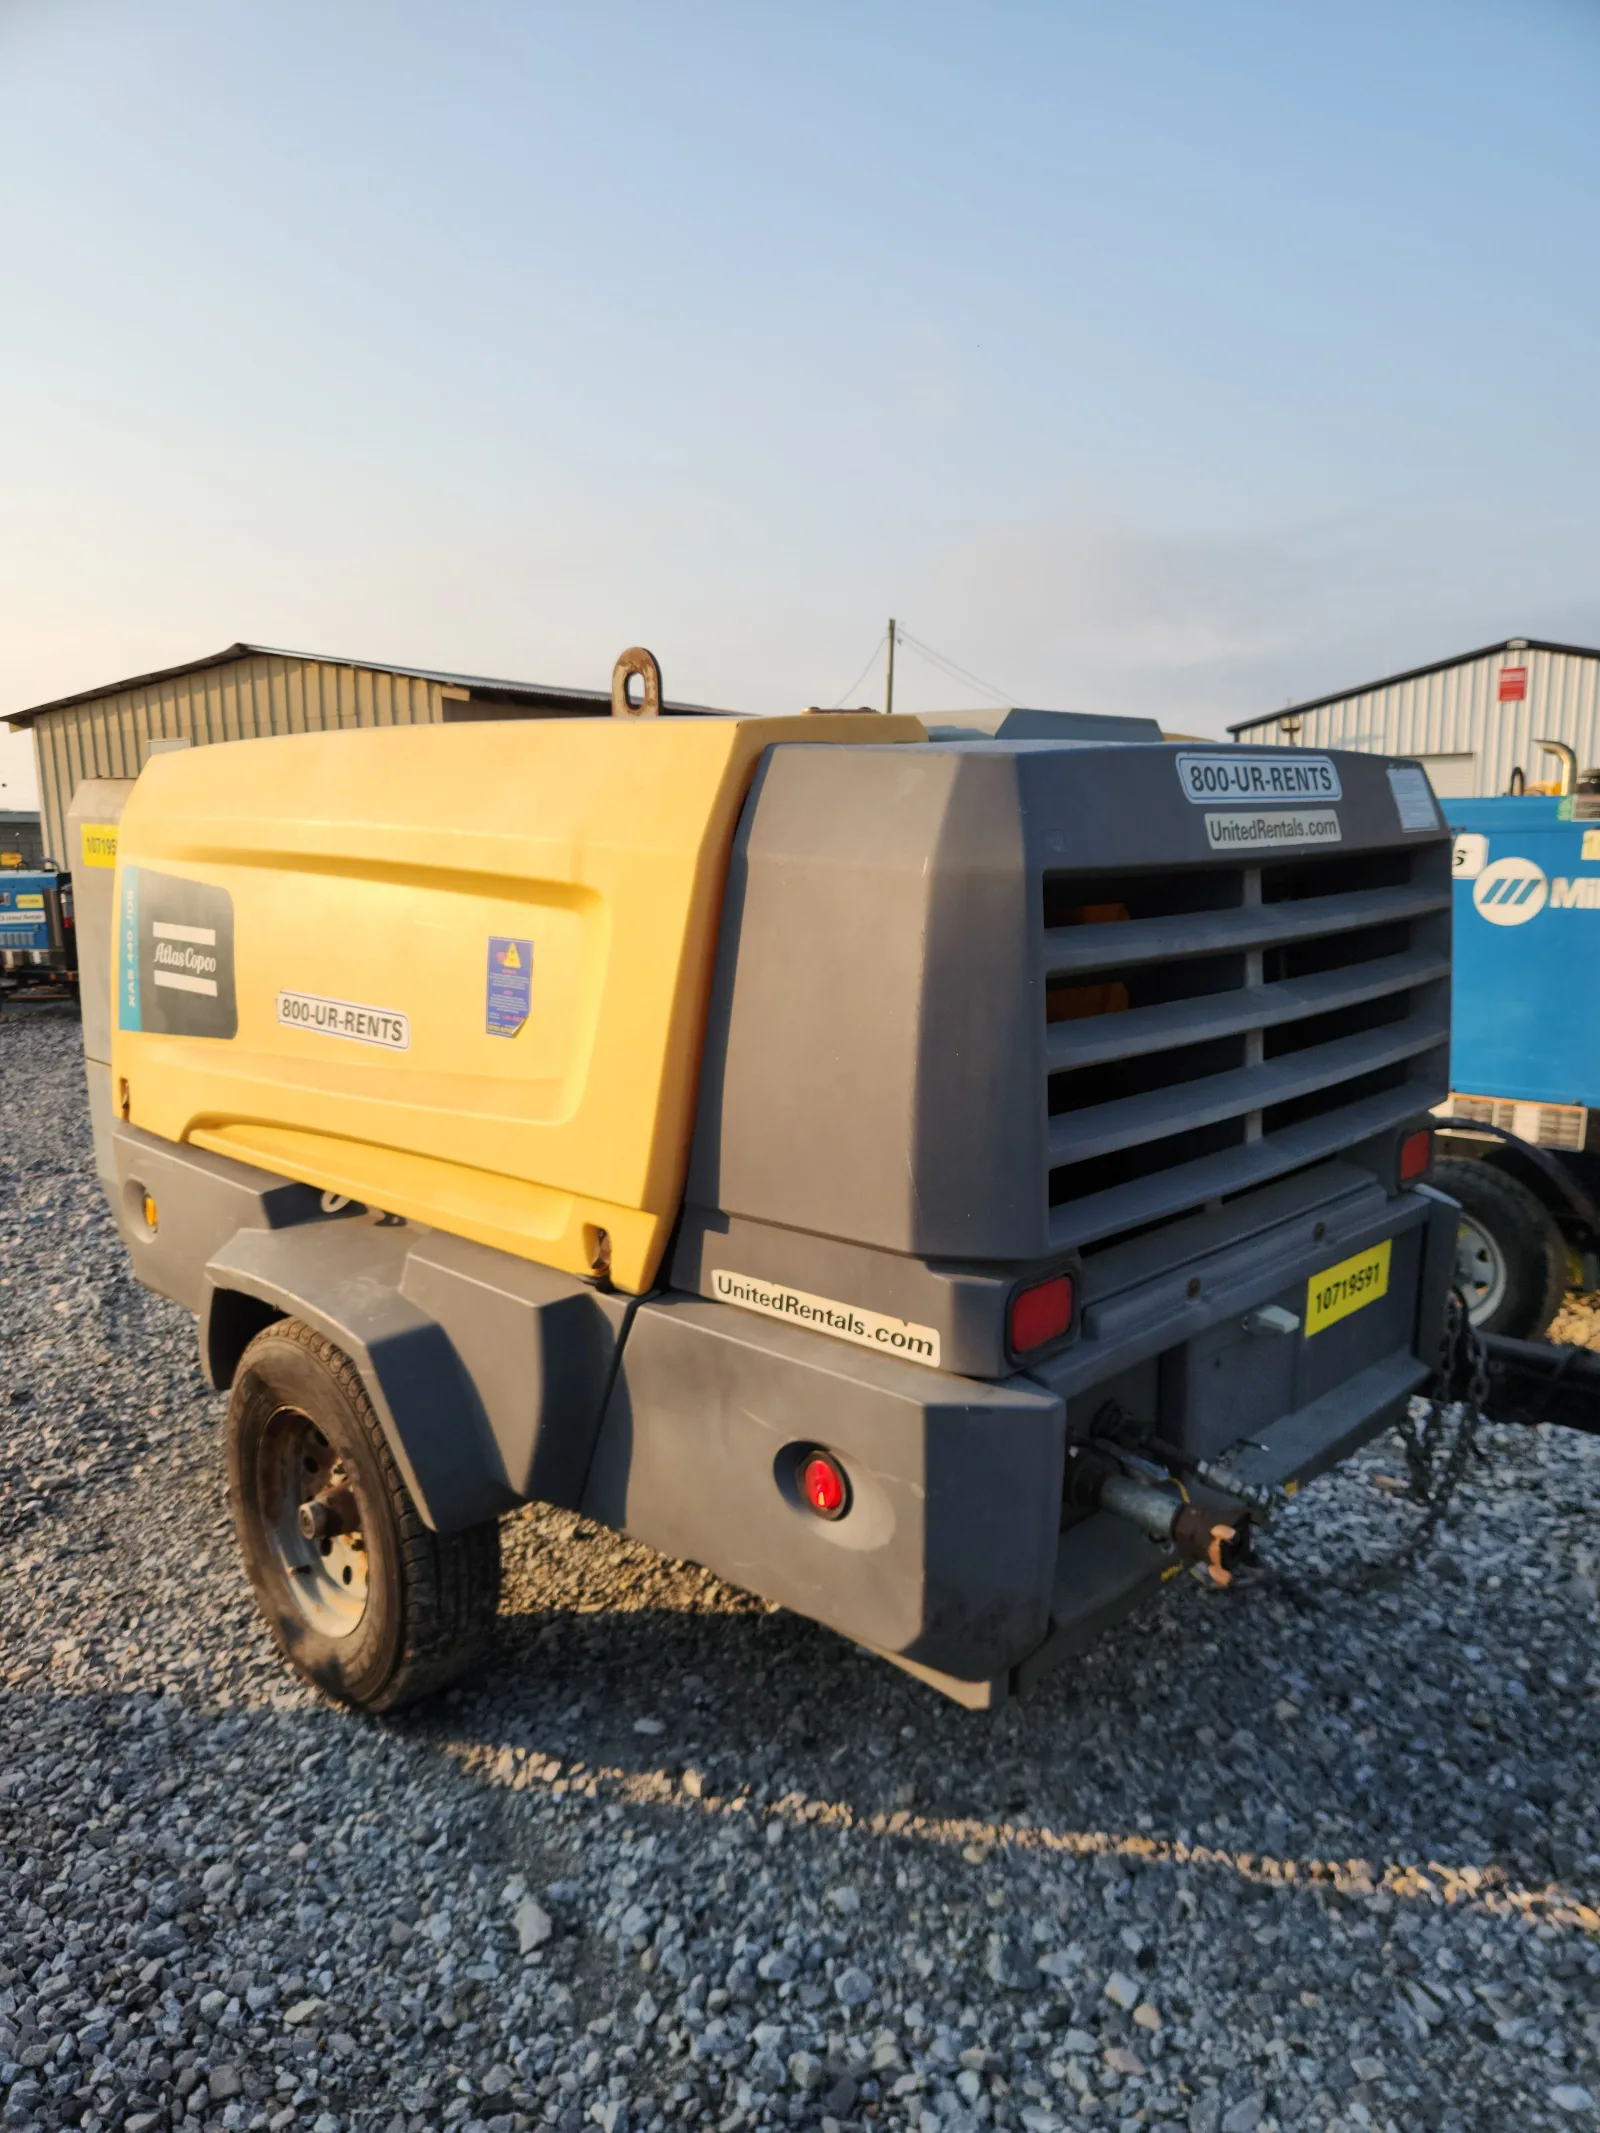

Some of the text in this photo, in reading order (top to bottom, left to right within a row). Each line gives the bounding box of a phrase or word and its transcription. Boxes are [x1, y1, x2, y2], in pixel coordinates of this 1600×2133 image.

[1190, 766, 1332, 792] 800-UR-RENTS
[1210, 817, 1337, 842] UnitedRentals.com
[126, 930, 134, 963] 440
[153, 942, 216, 975] Atlas Copco
[282, 998, 403, 1042] 800-UR-RENTS
[1316, 1262, 1380, 1314] 10719591
[718, 1275, 934, 1357] UnitedRentals.com
